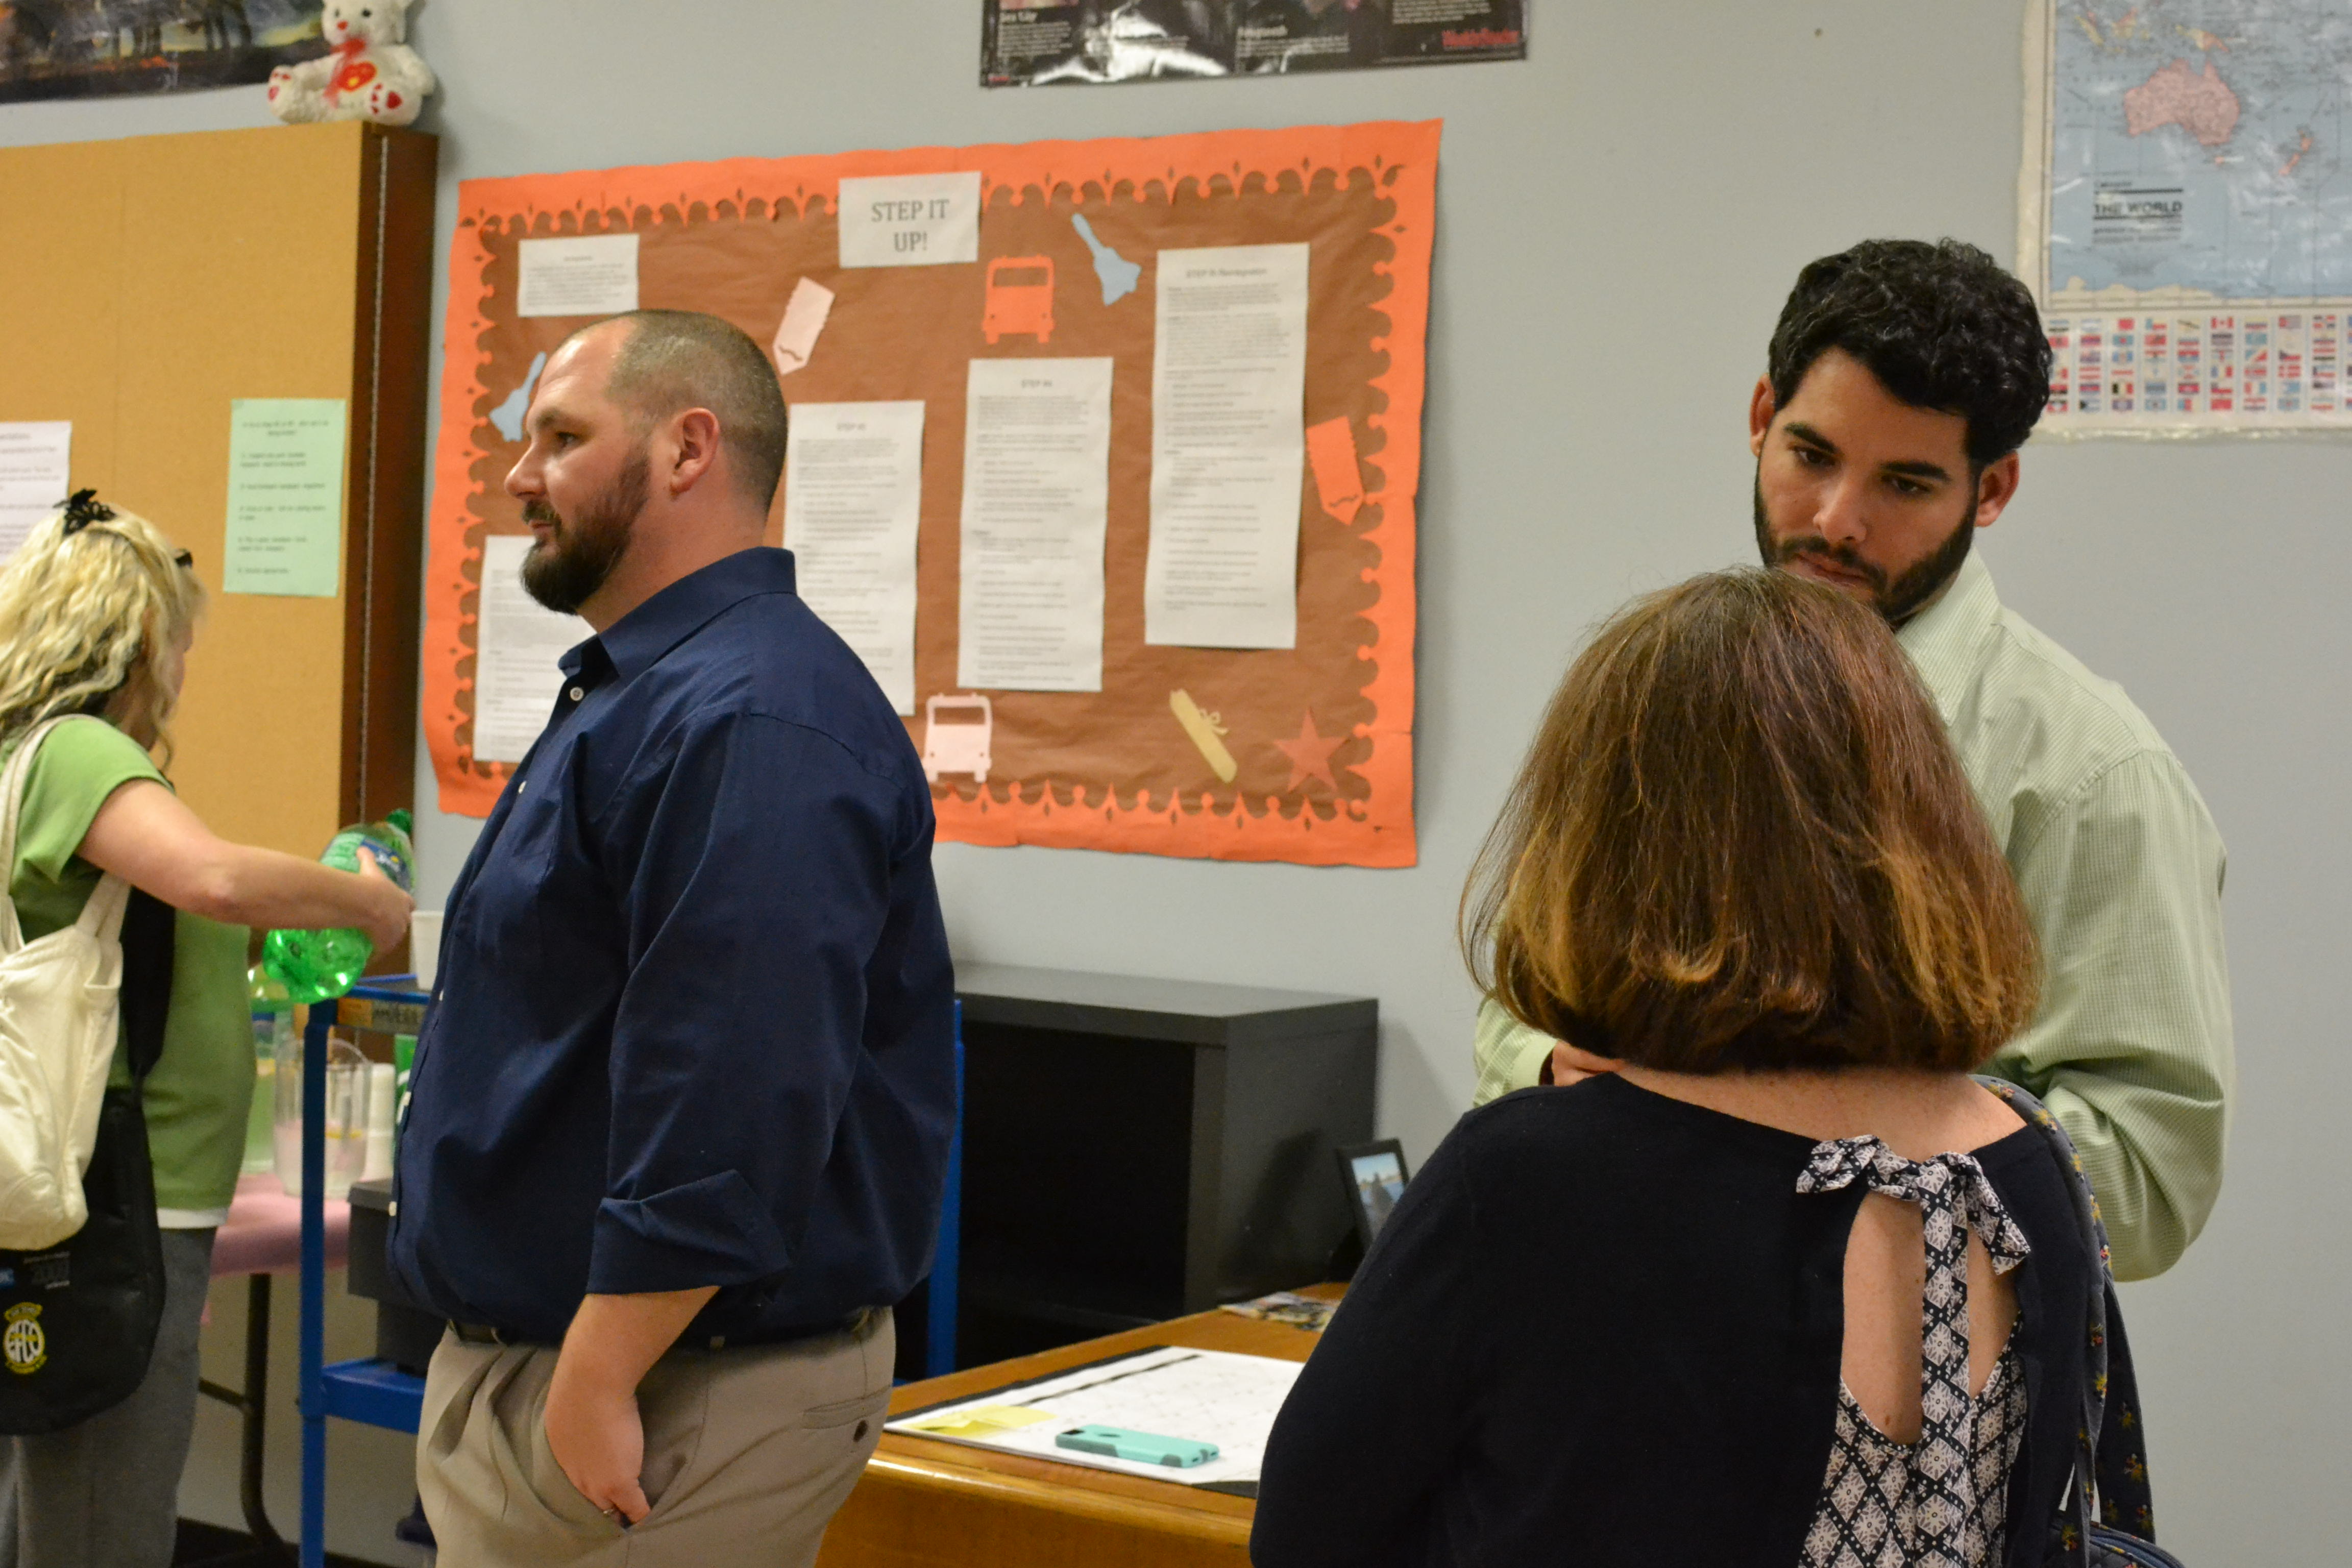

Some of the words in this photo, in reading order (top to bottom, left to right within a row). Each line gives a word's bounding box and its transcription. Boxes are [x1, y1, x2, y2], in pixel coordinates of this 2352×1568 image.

[871, 201, 924, 222] STEP
[928, 199, 950, 220] IT
[2127, 201, 2183, 214] WORLD
[893, 231, 927, 253] UP!
